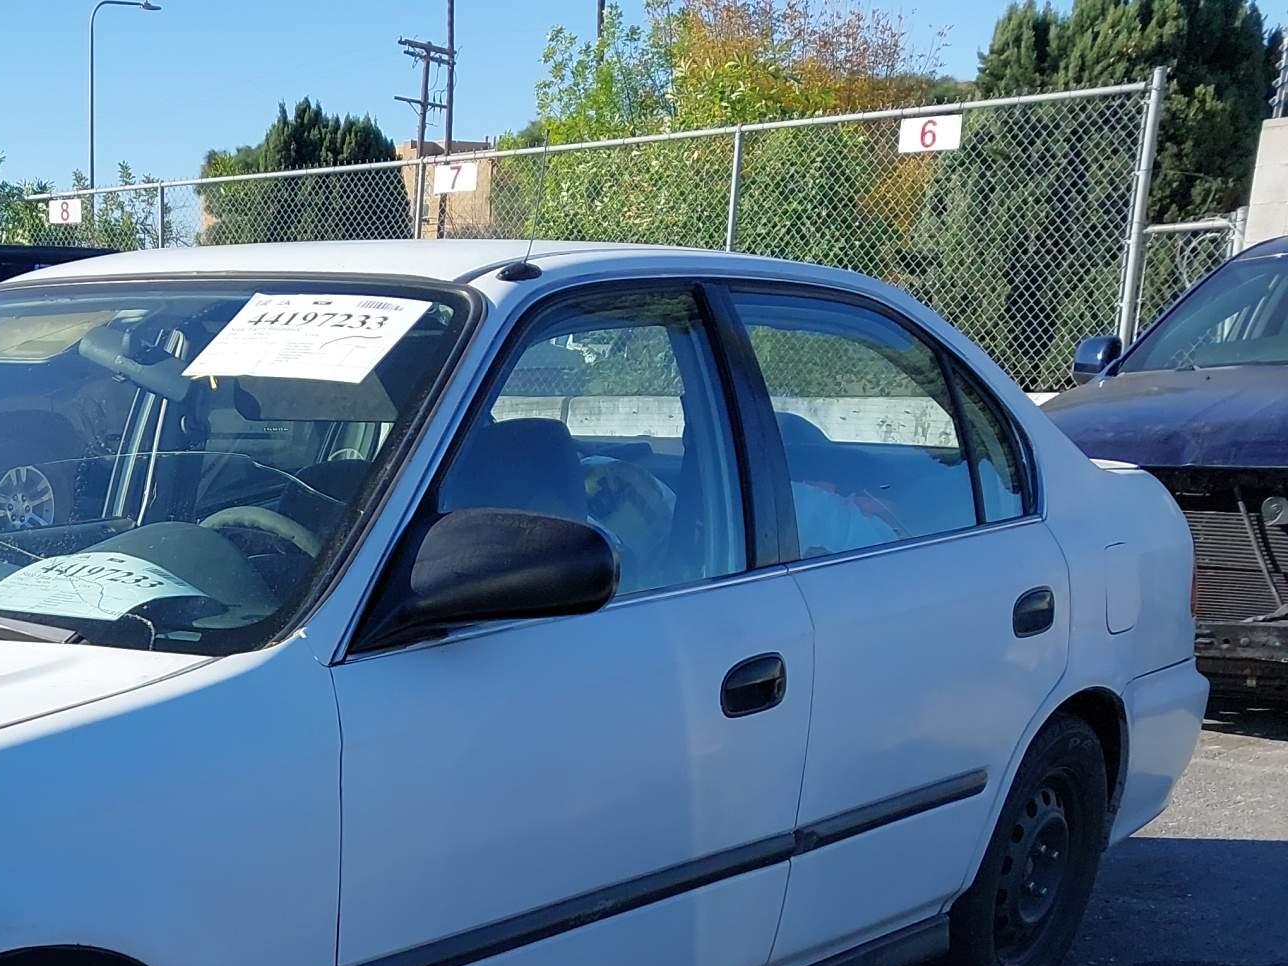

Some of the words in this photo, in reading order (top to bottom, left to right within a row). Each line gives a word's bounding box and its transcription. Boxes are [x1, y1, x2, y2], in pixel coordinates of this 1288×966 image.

[920, 119, 937, 148] 6
[450, 165, 462, 190] 7
[60, 201, 70, 221] 8
[247, 311, 389, 330] 44197233
[40, 561, 165, 589] 44197233
